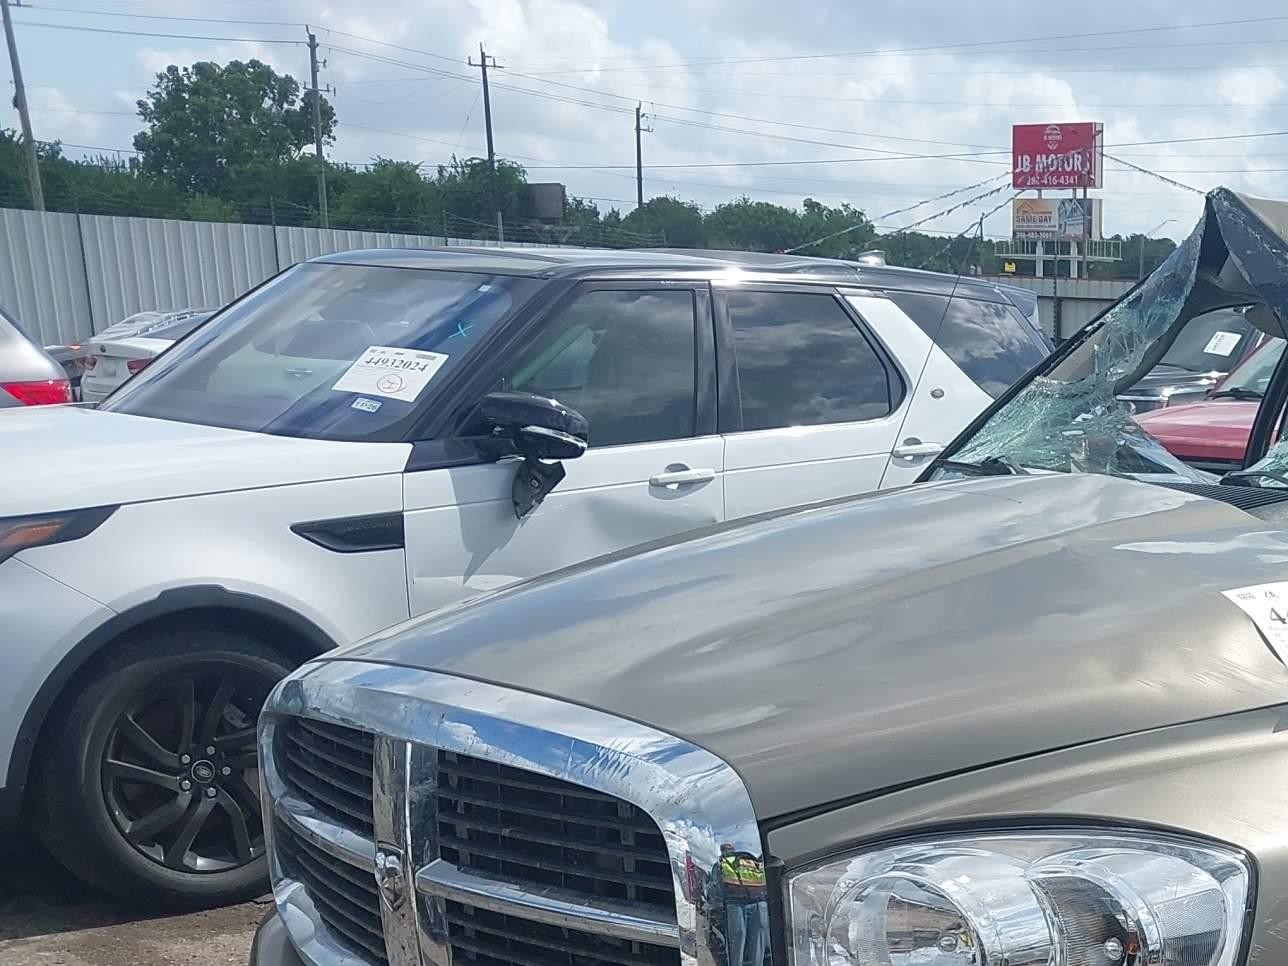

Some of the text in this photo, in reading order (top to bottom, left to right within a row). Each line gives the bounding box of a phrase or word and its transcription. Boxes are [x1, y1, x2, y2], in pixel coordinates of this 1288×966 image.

[1016, 215, 1052, 223] SAME DAY
[365, 356, 429, 373] 44932024
